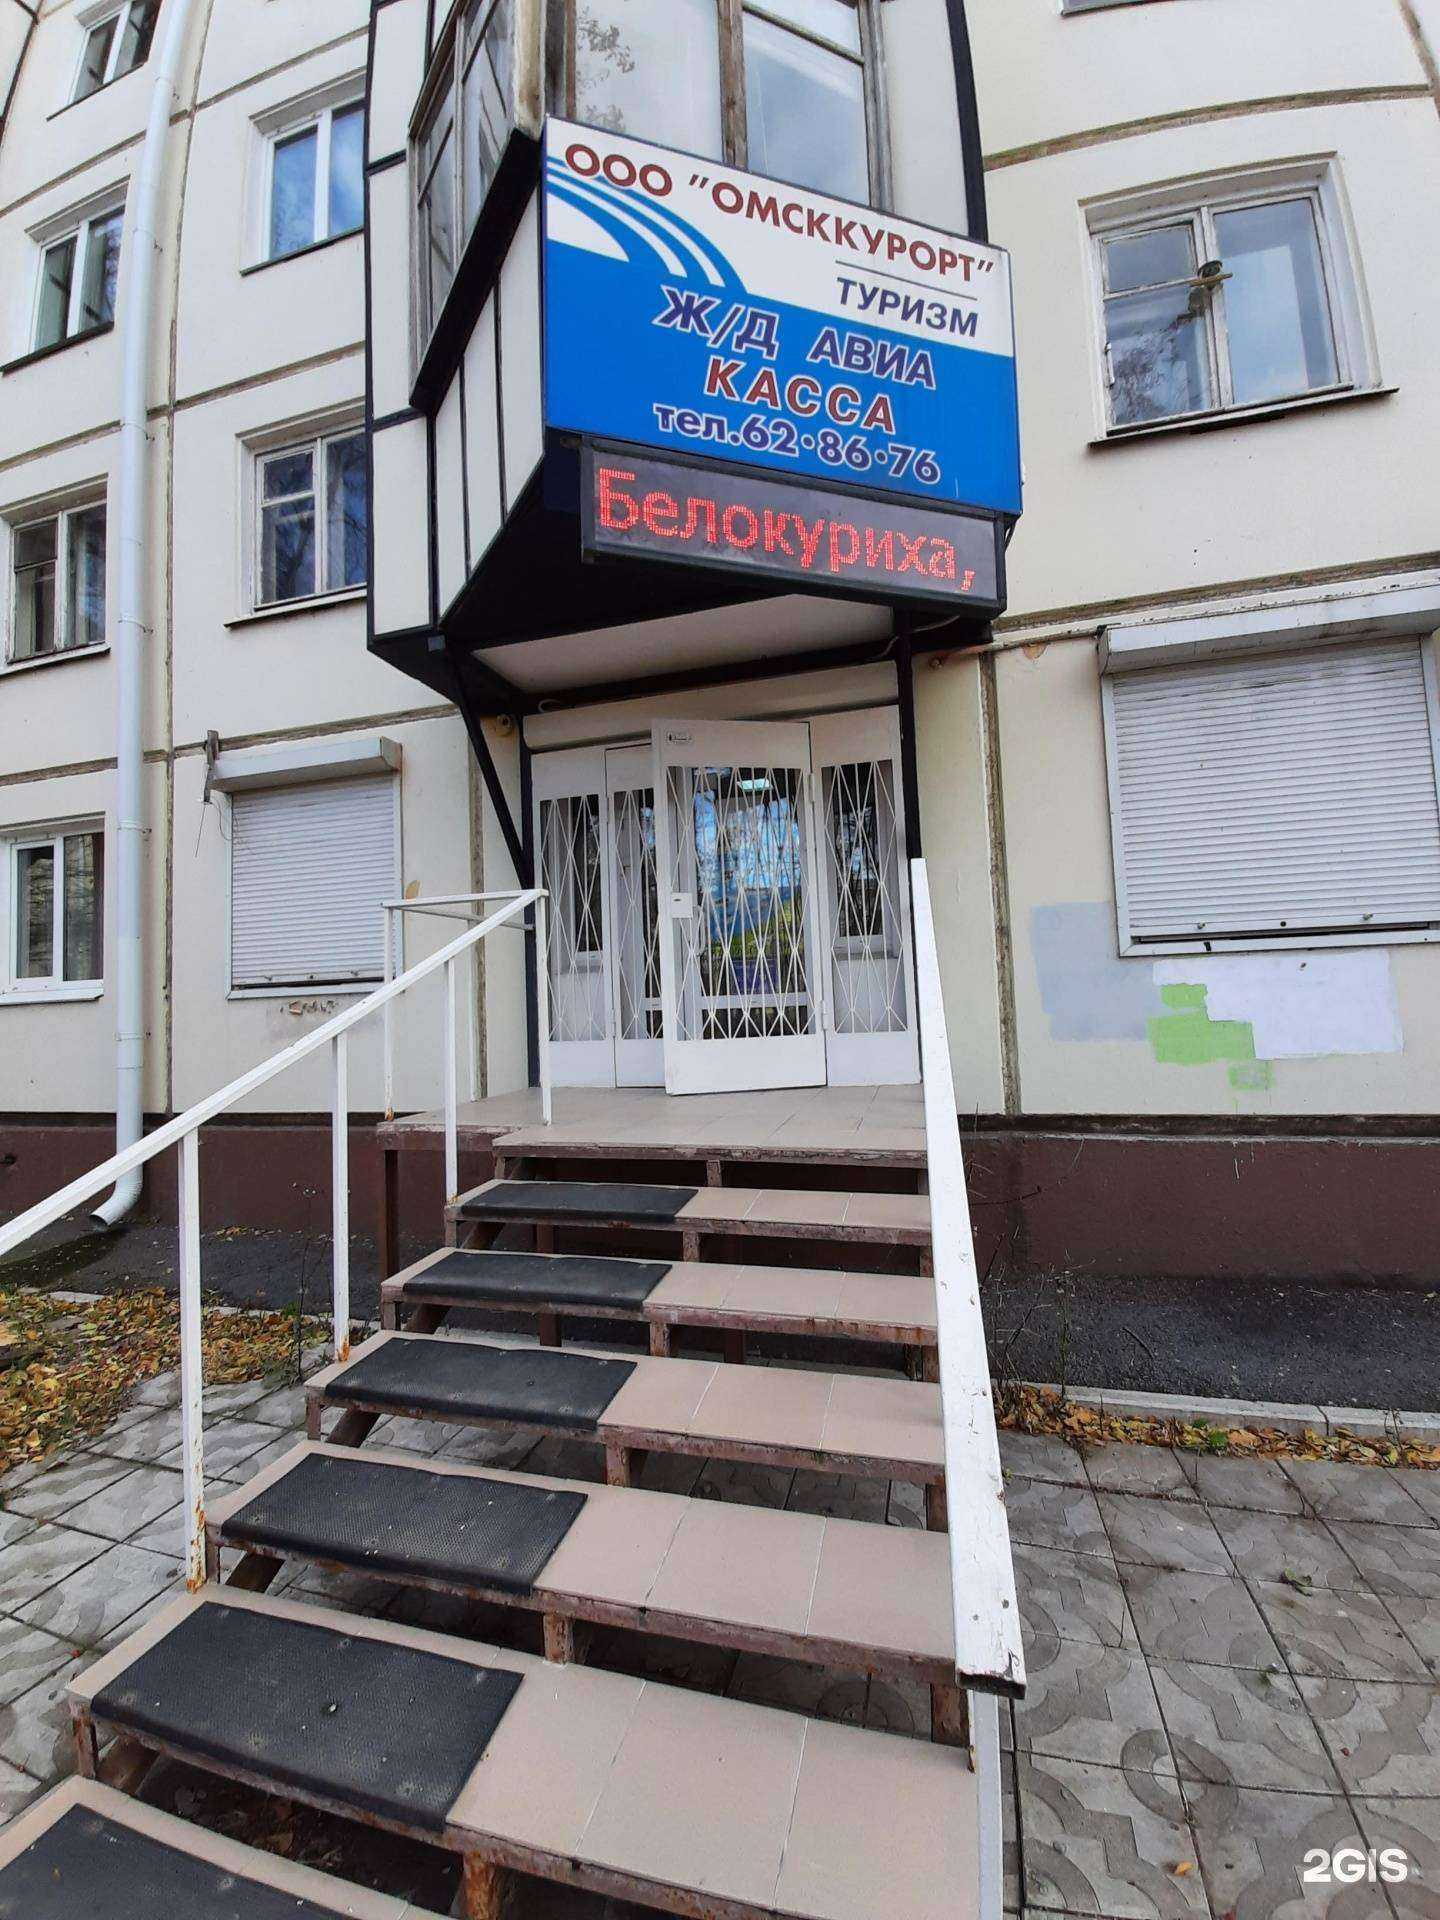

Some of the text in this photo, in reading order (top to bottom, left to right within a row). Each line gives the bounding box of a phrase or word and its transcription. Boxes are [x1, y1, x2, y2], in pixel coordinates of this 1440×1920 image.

[564, 143, 995, 282] ООО "ОМСККУРОРТ"
[653, 284, 936, 391] Ж/Д АВИА
[836, 277, 979, 338] ТУРИЗМ
[703, 355, 896, 434] КАССА
[598, 467, 975, 592] Белокуриха,
